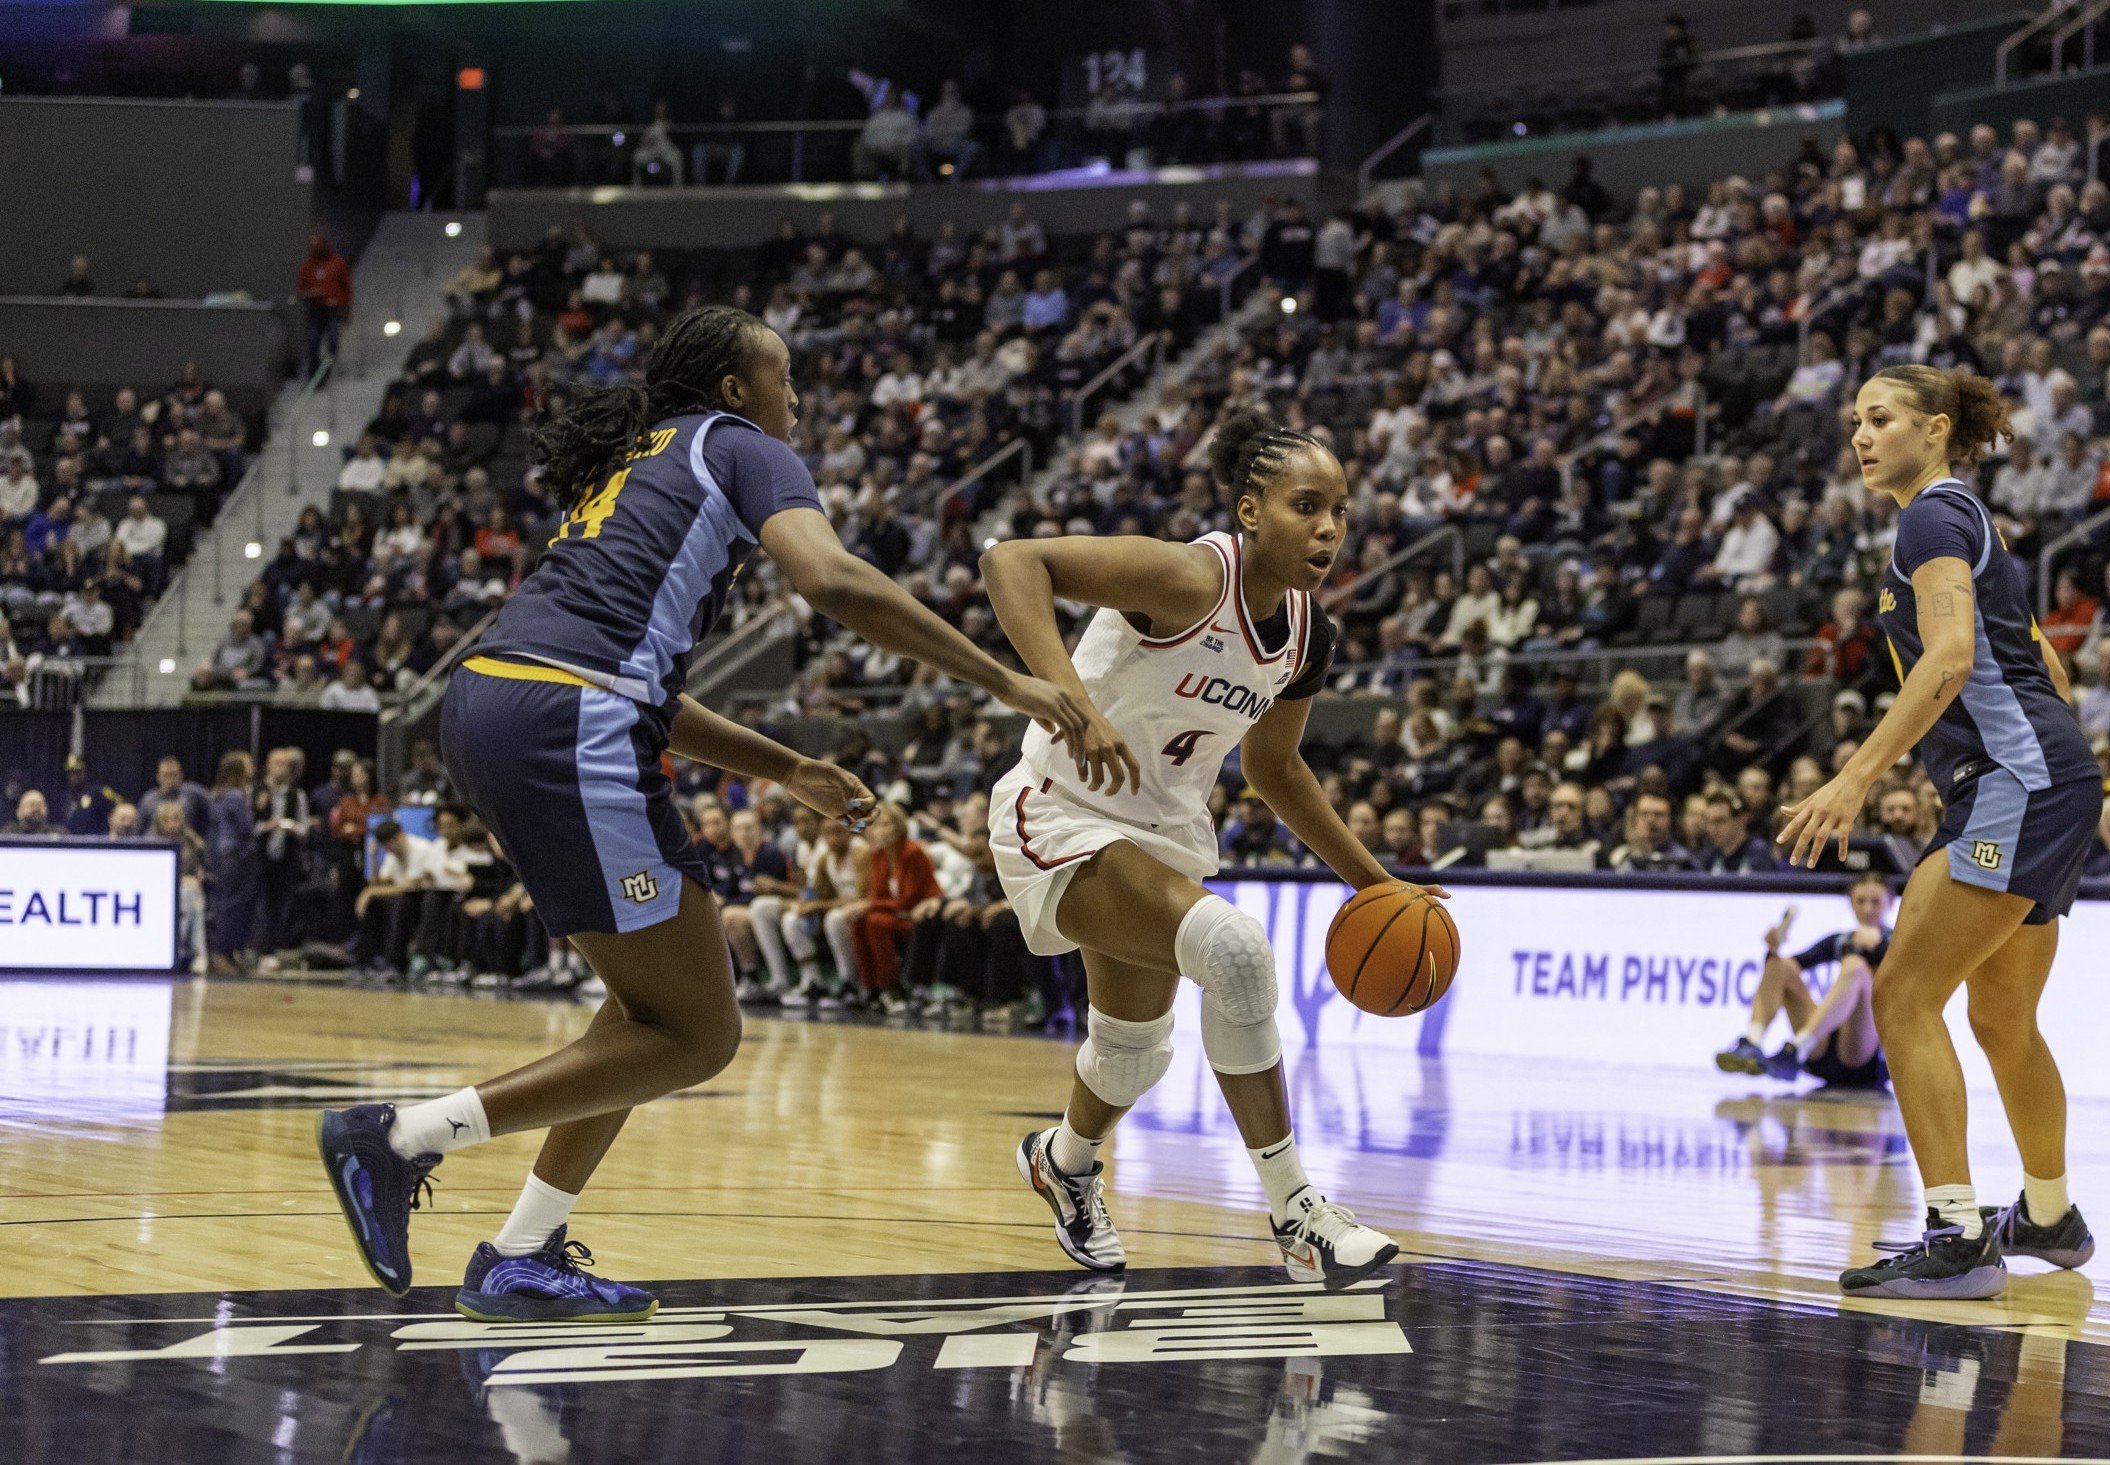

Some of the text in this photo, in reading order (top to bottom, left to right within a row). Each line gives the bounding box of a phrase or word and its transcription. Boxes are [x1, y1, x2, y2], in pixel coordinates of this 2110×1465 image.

[1161, 730, 1218, 767] 4
[1971, 840, 2003, 870] MU
[619, 870, 659, 904] MU
[1512, 951, 1609, 1000] TEAM
